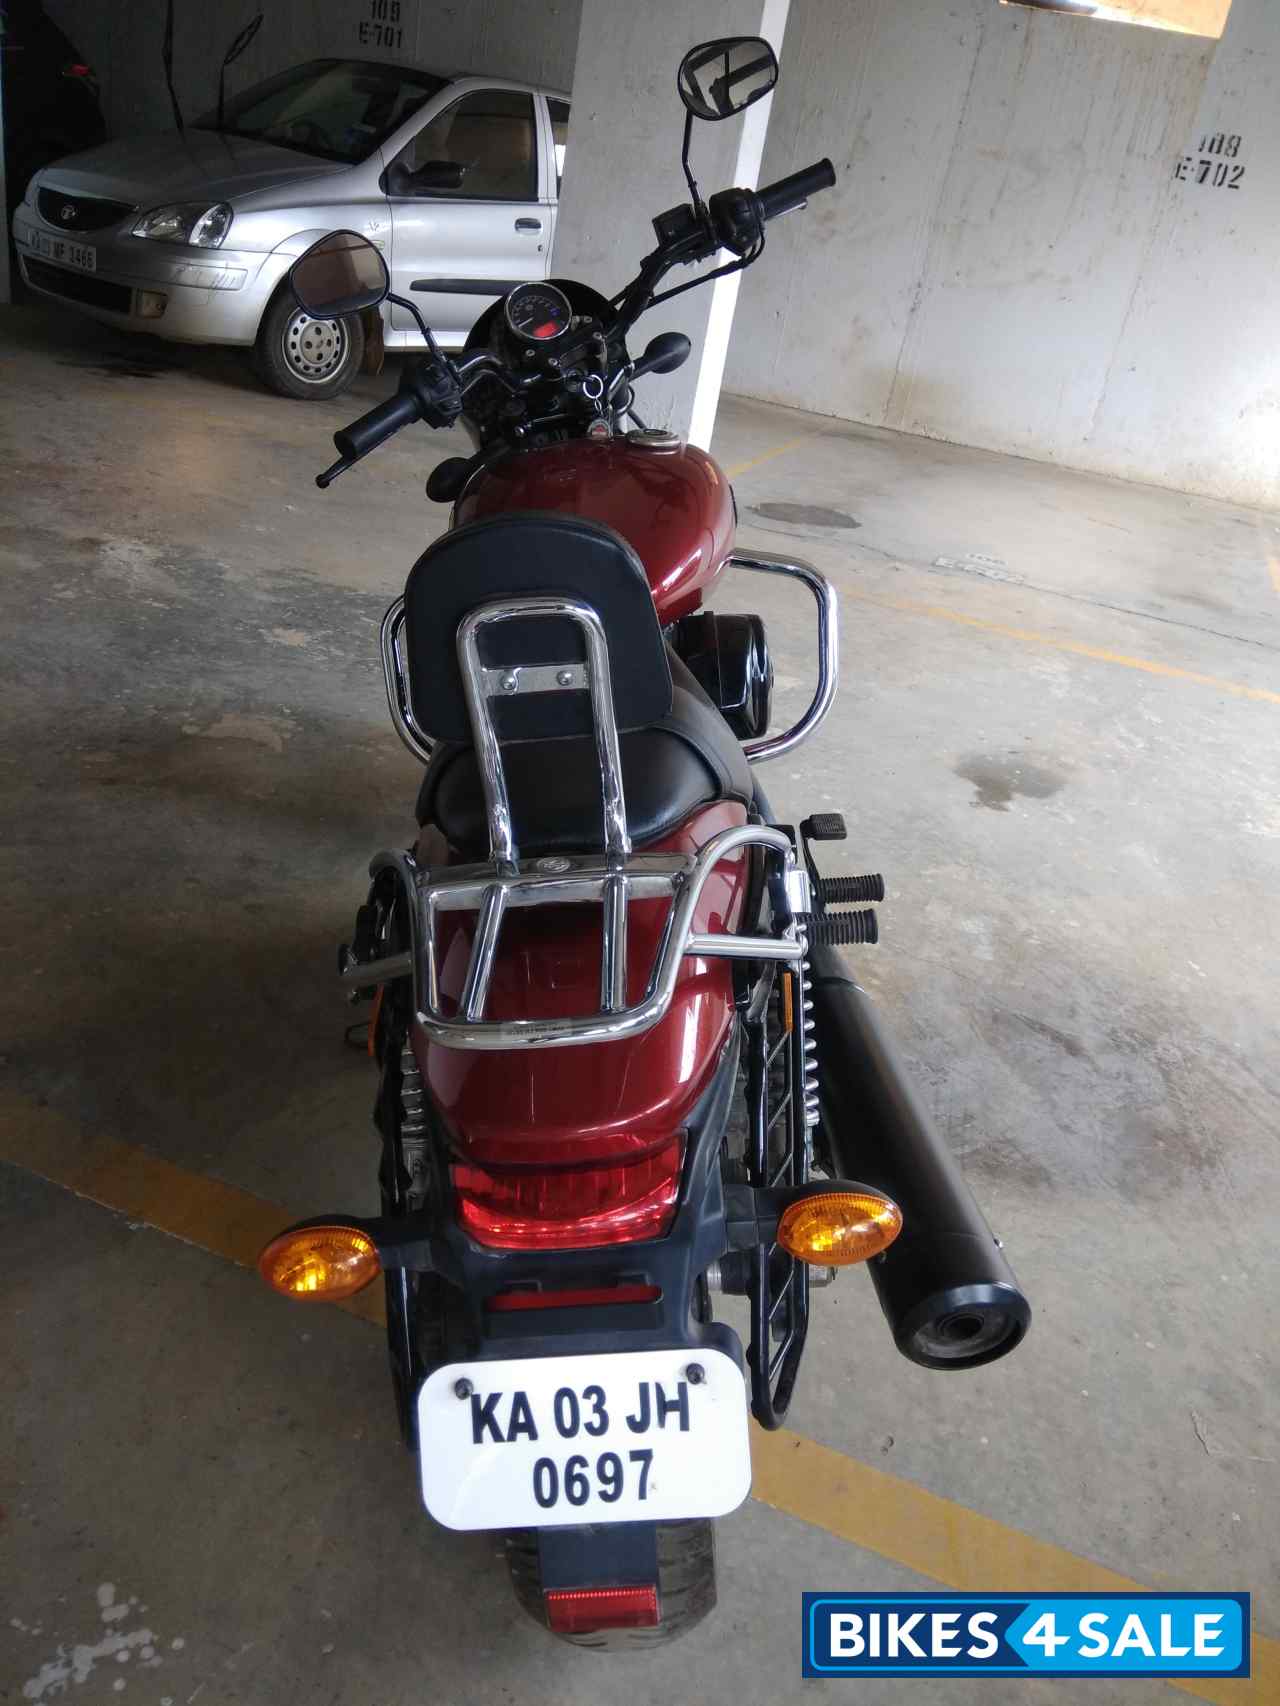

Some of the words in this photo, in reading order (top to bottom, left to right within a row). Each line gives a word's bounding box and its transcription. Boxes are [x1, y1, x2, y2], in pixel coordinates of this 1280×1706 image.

[471, 1391, 539, 1444] KA
[554, 1385, 609, 1438] 03
[626, 1382, 690, 1434] JH
[532, 1449, 654, 1508] 0697
